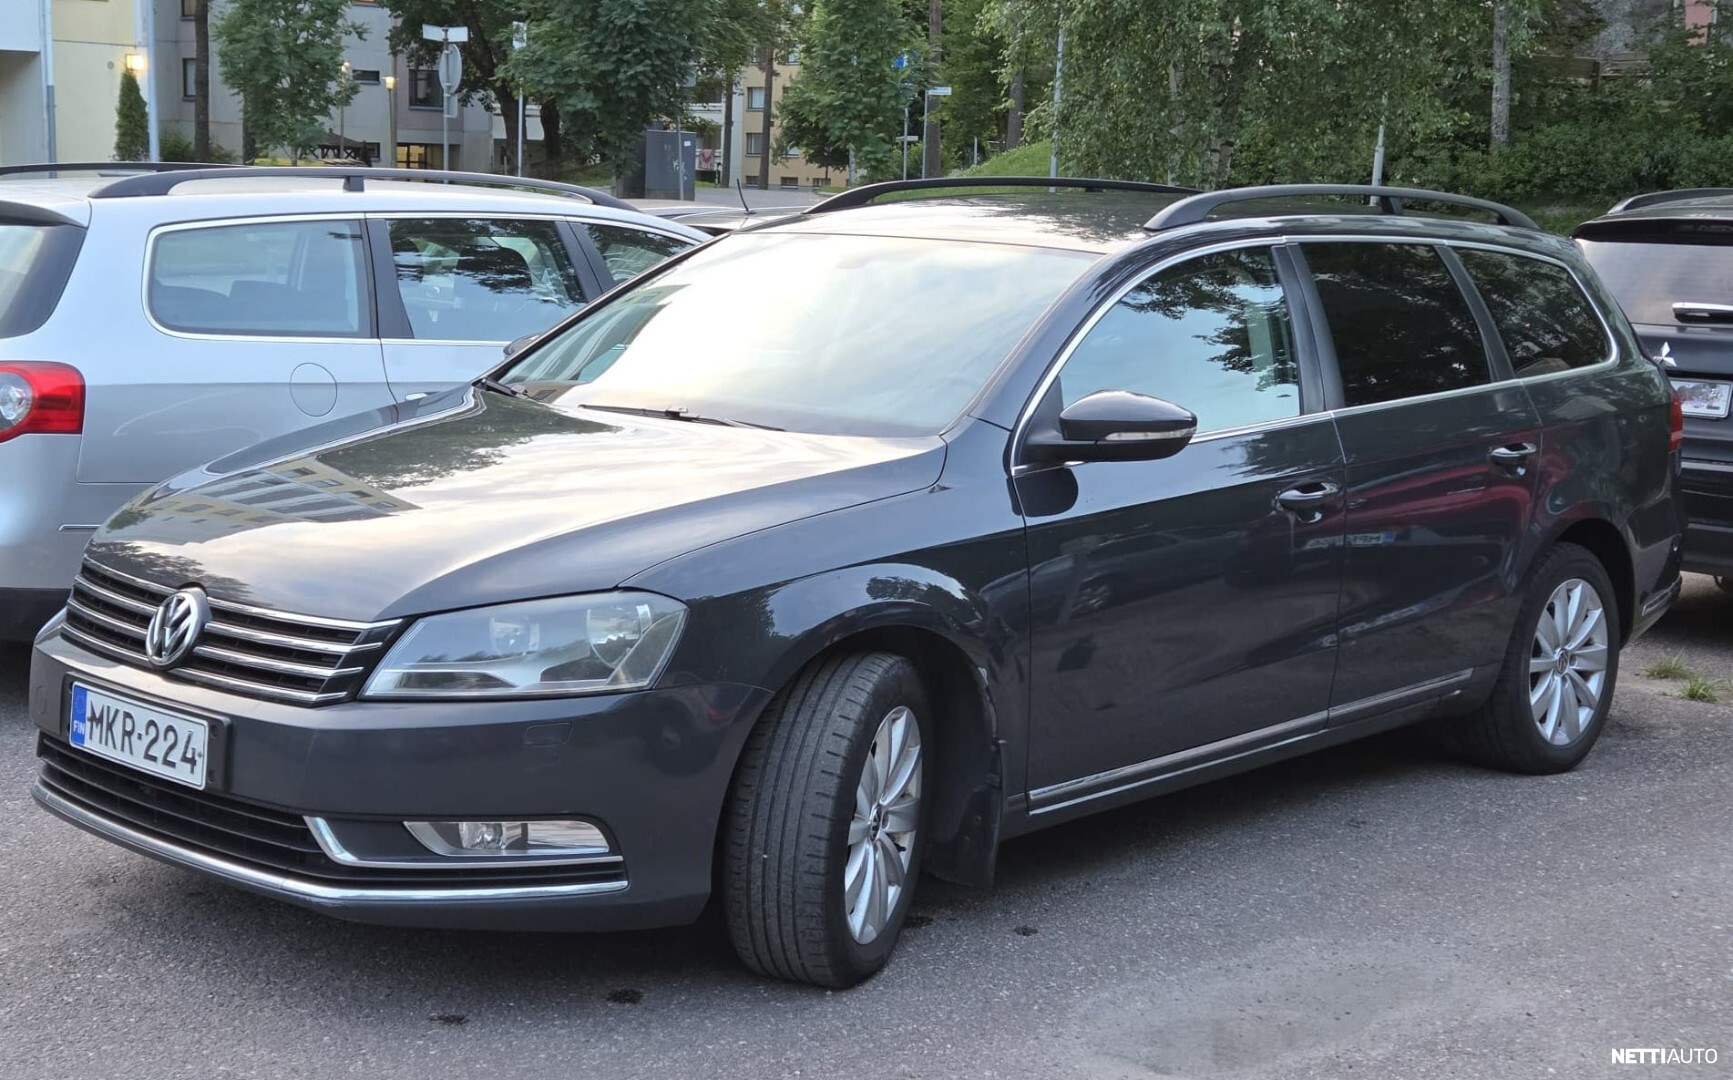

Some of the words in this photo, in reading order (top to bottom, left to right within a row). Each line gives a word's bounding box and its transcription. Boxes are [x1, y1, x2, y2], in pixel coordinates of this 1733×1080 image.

[148, 590, 197, 664] VW
[73, 719, 86, 735] FIN
[87, 699, 197, 774] MKR-224
